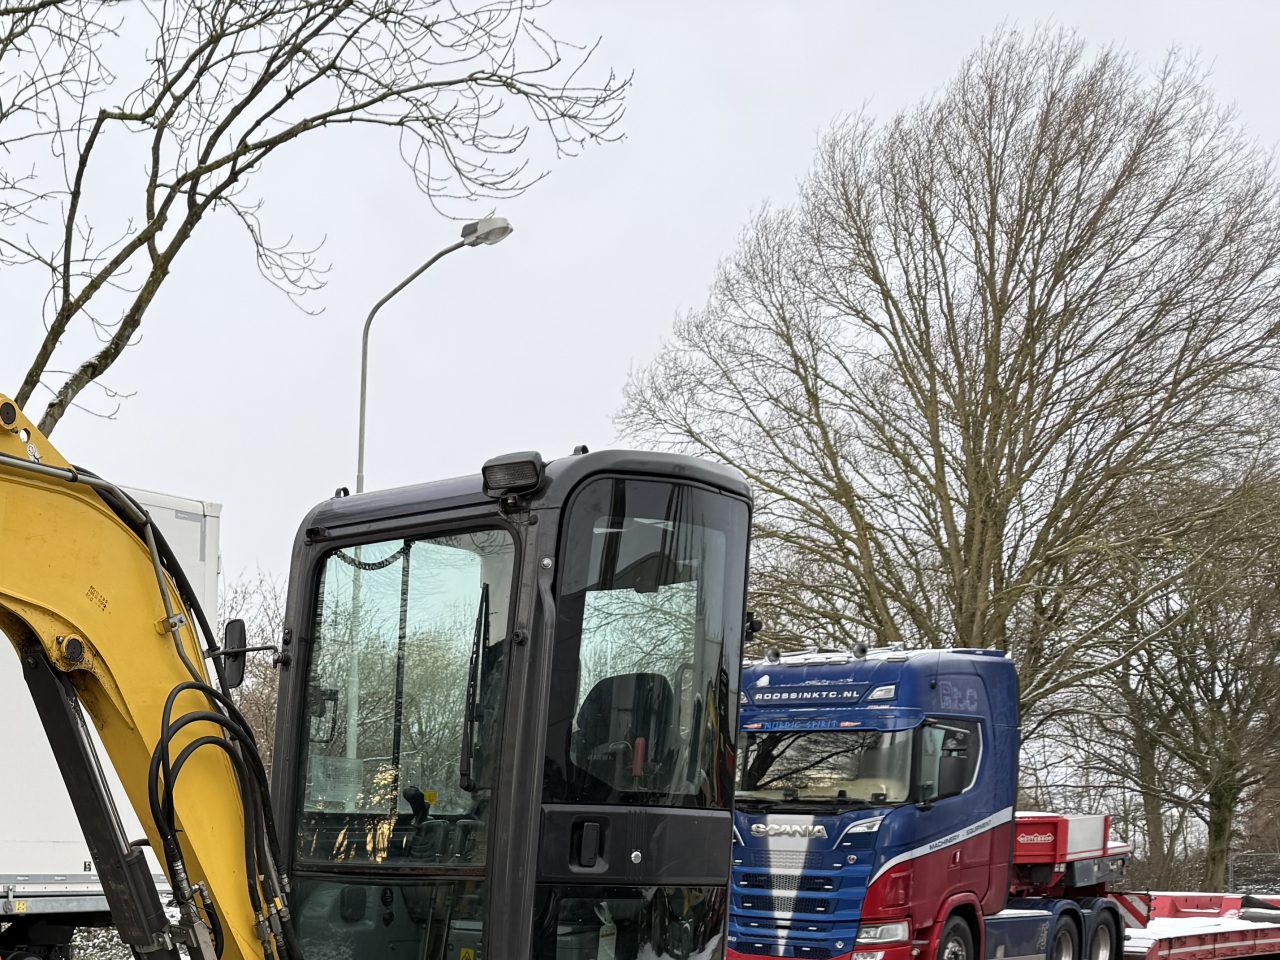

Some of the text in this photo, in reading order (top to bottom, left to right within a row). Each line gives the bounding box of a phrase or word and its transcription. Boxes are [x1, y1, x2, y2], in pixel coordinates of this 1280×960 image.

[754, 691, 860, 701] ROOSSINKTC.NL
[750, 823, 829, 839] SCANIA
[929, 833, 960, 851] MACHINERY
